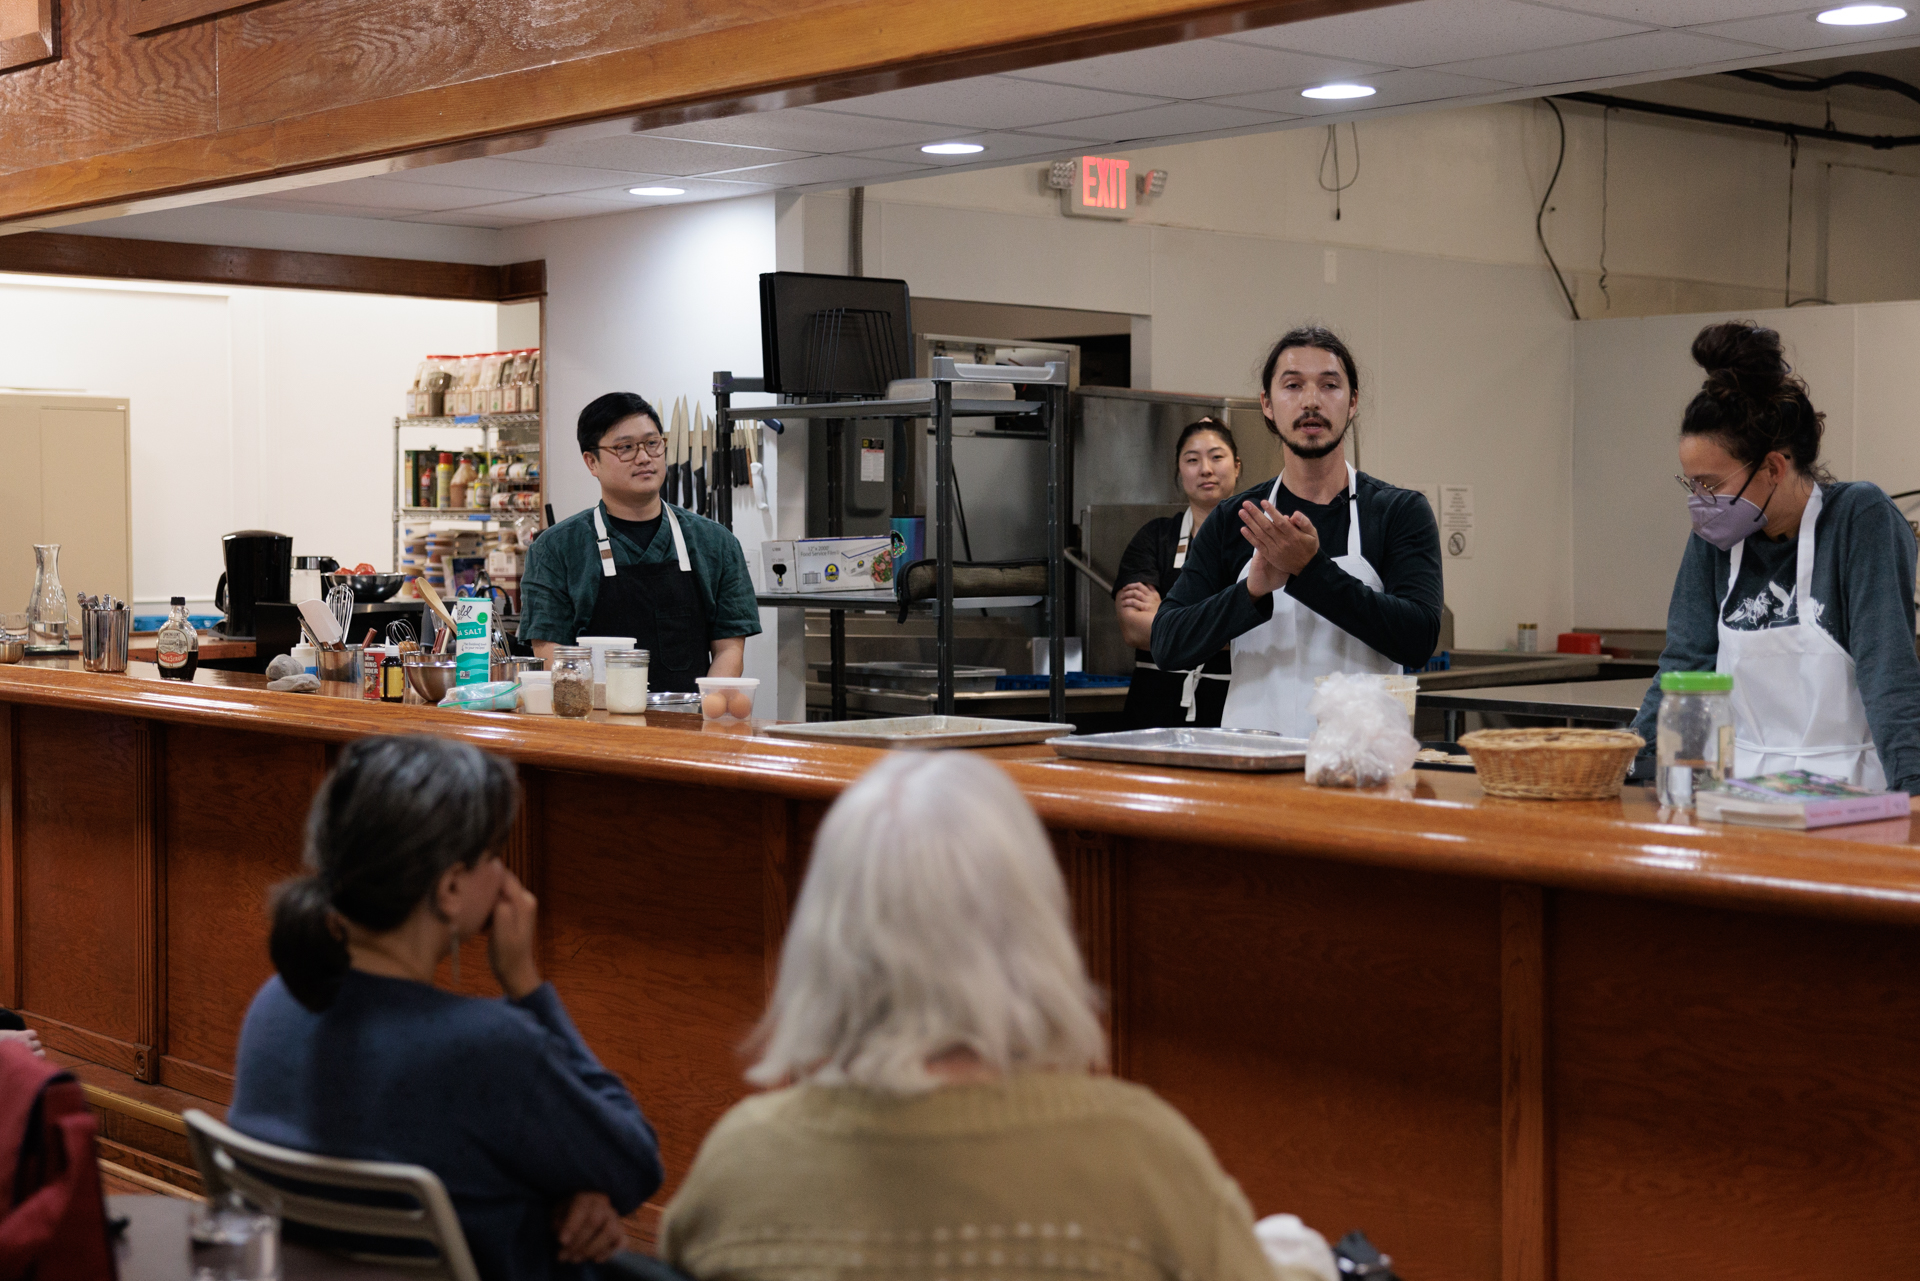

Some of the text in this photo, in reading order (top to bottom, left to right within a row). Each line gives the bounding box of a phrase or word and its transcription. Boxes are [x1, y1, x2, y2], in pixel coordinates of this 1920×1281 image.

[1082, 156, 1130, 210] EXIT
[457, 605, 473, 619] eld
[464, 628, 482, 636] SALT
